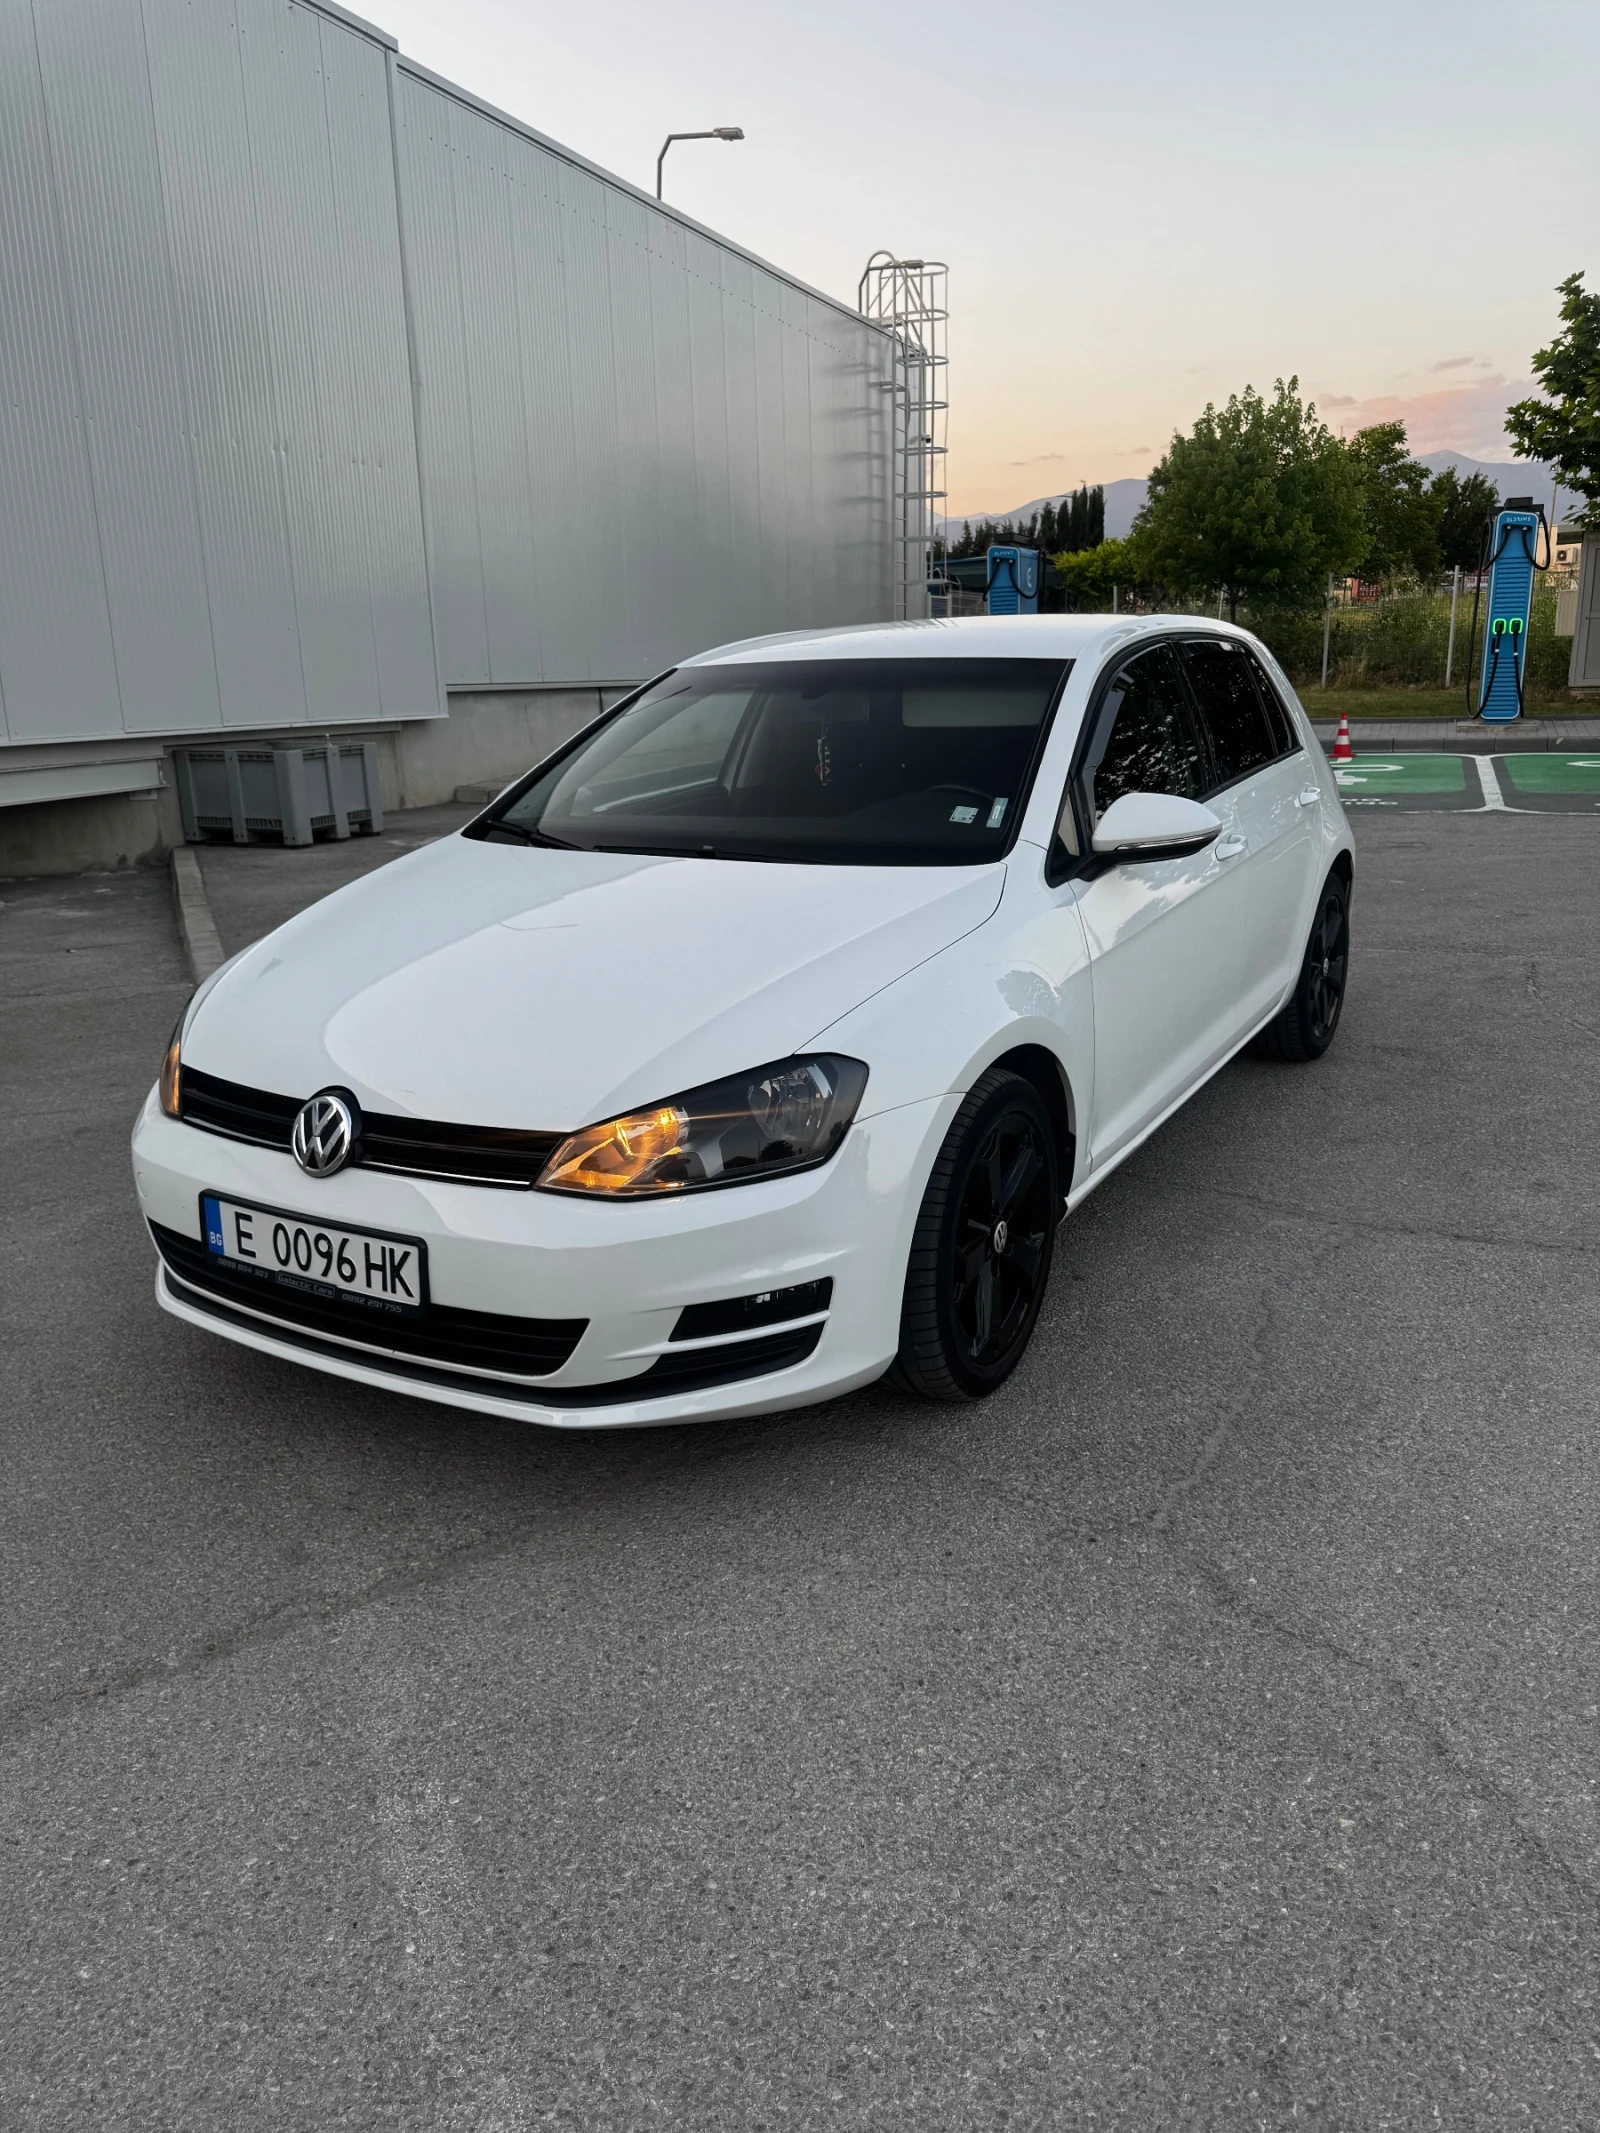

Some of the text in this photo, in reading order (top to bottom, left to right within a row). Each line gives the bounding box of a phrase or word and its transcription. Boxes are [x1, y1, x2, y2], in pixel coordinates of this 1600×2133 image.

[209, 1231, 223, 1246] BG
[234, 1210, 415, 1298] E 0096 HK
[277, 1274, 334, 1297] Galactic Cars
